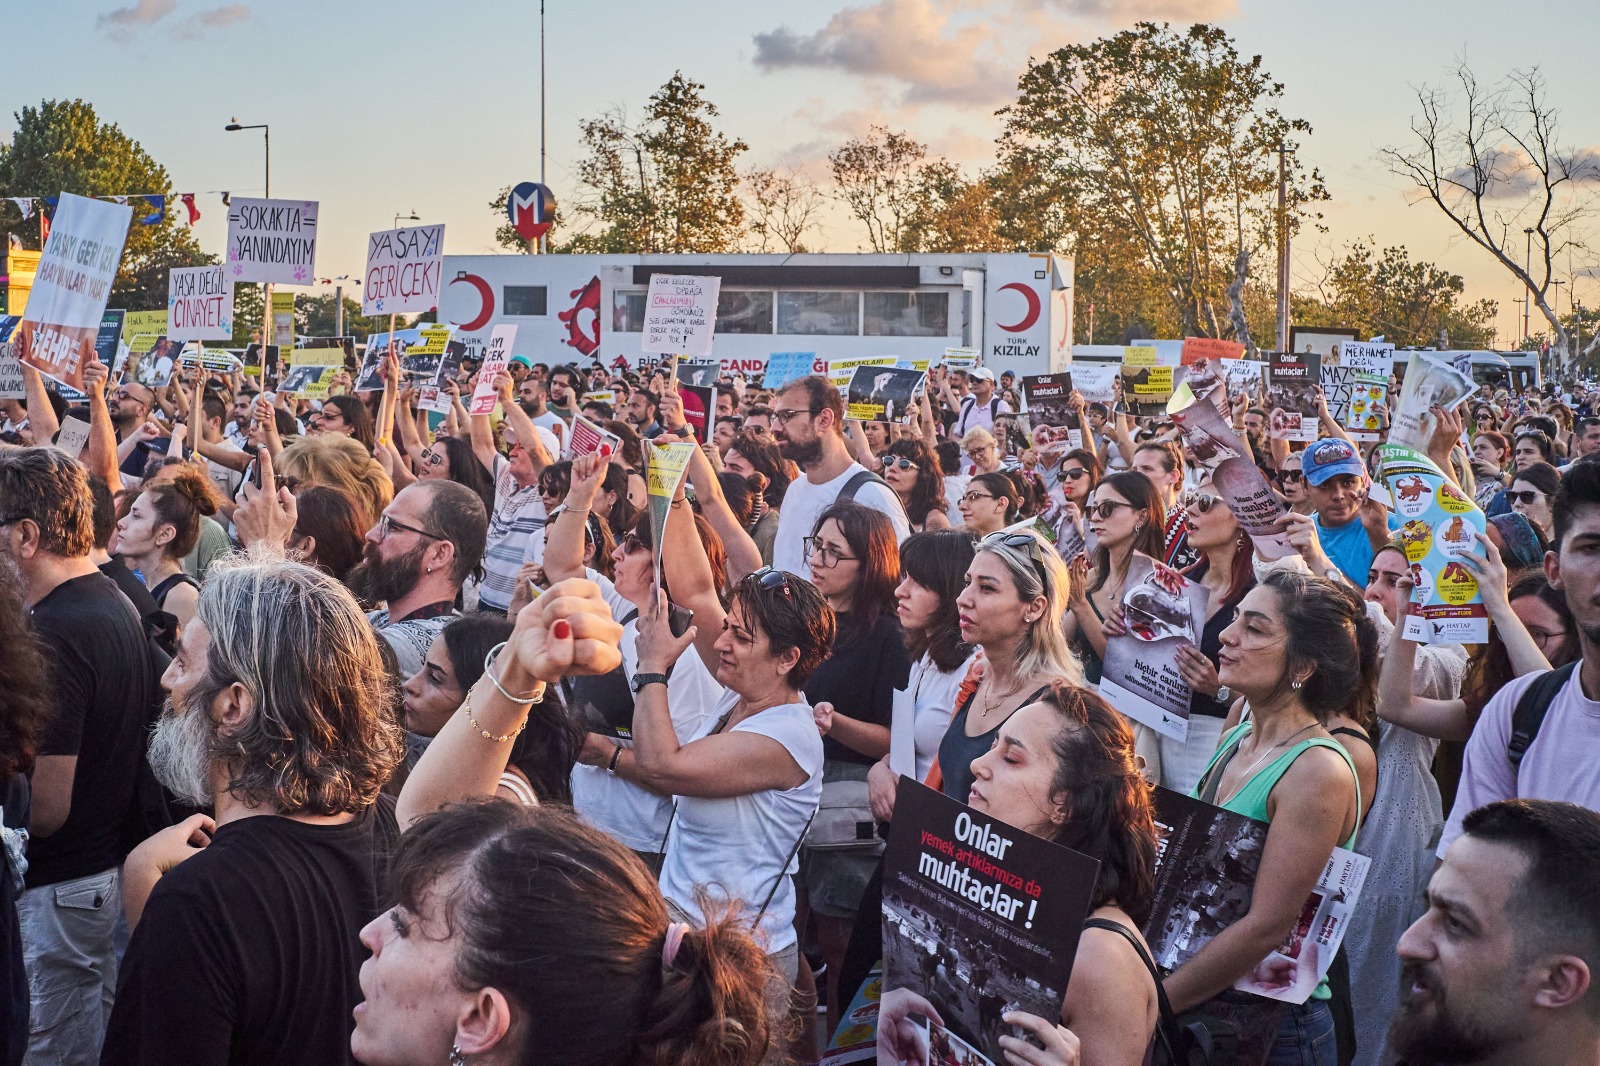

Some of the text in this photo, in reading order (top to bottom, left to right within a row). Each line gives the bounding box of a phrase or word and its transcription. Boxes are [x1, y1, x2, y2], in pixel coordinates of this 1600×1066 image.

[513, 189, 539, 225] M
[236, 235, 314, 265] YANINDAYIM
[370, 228, 441, 261] YASAYI
[199, 267, 228, 295] DEĞİL
[174, 297, 223, 328] CİNAYET
[993, 345, 1040, 356] KIZILAY
[1280, 354, 1298, 362] Onlar
[1346, 347, 1394, 359] MERHAMET
[1350, 358, 1374, 367] DEĞİL
[1274, 367, 1304, 376] muhtaçlar
[1033, 386, 1060, 396] muhtaçlar
[1241, 498, 1275, 513] canlıya
[1125, 674, 1153, 693] edilmesine
[1154, 689, 1165, 698] izin
[1134, 659, 1189, 694] hiçbir canlıya
[1141, 675, 1157, 687] eziyet
[1167, 687, 1188, 701] işkence
[954, 811, 1013, 860] Onlar
[921, 829, 1042, 898] yemek artıklarınıza da
[1340, 860, 1351, 885] HAYTAP
[918, 851, 1038, 929] muhtaçlar !
